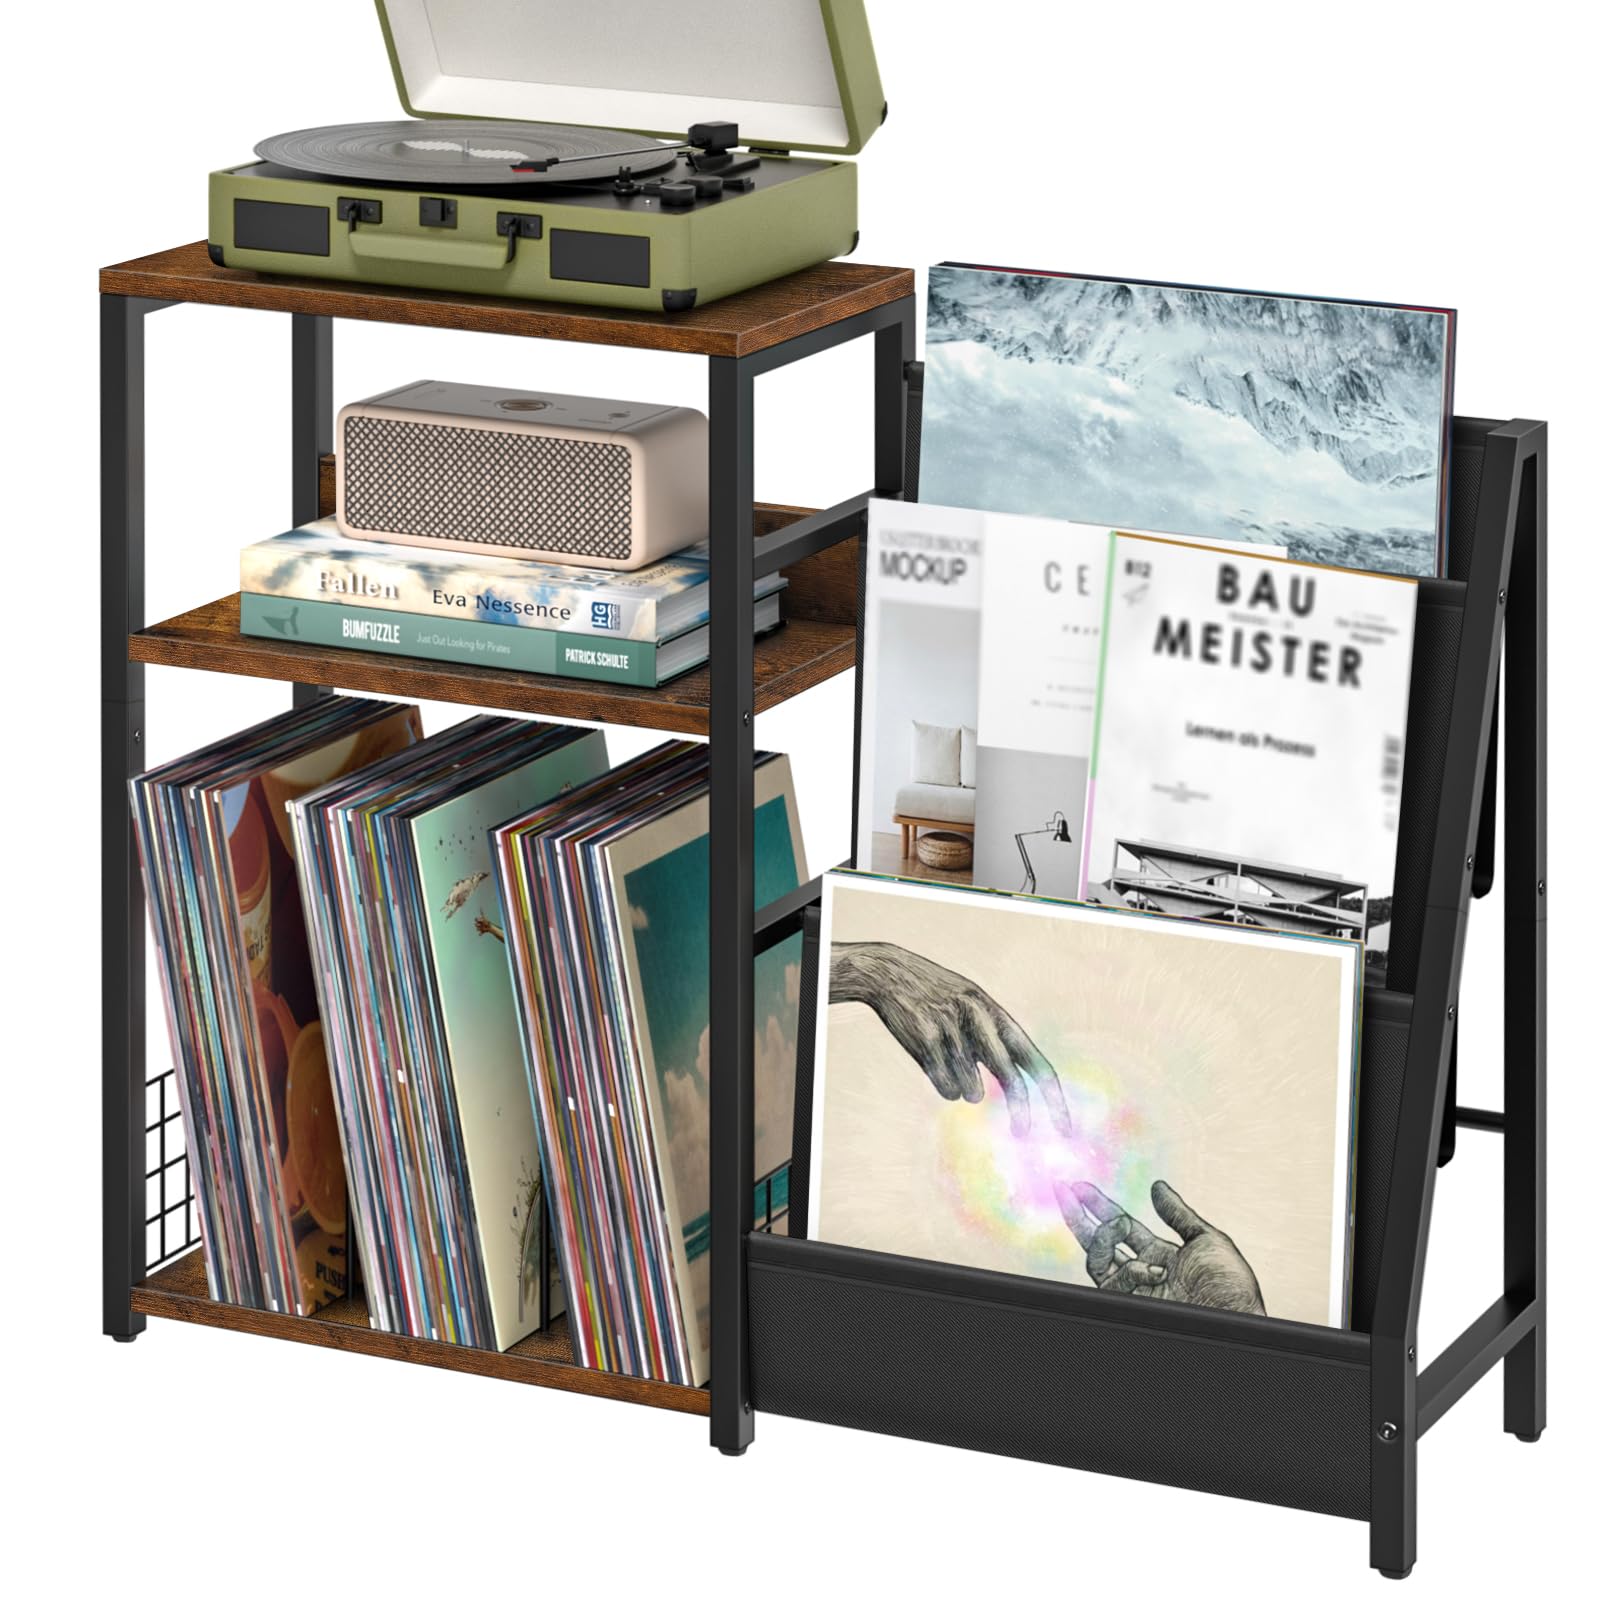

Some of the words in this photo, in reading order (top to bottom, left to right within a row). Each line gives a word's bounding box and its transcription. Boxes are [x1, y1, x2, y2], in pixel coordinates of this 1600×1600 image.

[880, 550, 968, 585] MOCKUP
[316, 571, 398, 601] Fallen
[1217, 563, 1316, 617] BAU
[432, 588, 466, 609] Eva
[477, 594, 572, 621] Nessence
[343, 618, 400, 644] BUMFUZZLE
[417, 632, 431, 644] Just
[432, 634, 446, 647] Out
[447, 636, 475, 653] Looking
[475, 640, 485, 651] for
[487, 641, 511, 655] Pirates
[565, 648, 595, 665] PATRICK
[596, 652, 629, 670] SCHULTE
[1153, 615, 1363, 689] MEISTER
[1185, 719, 1235, 742] Lernen
[1239, 731, 1259, 747] als
[1263, 733, 1316, 759] Prozess
